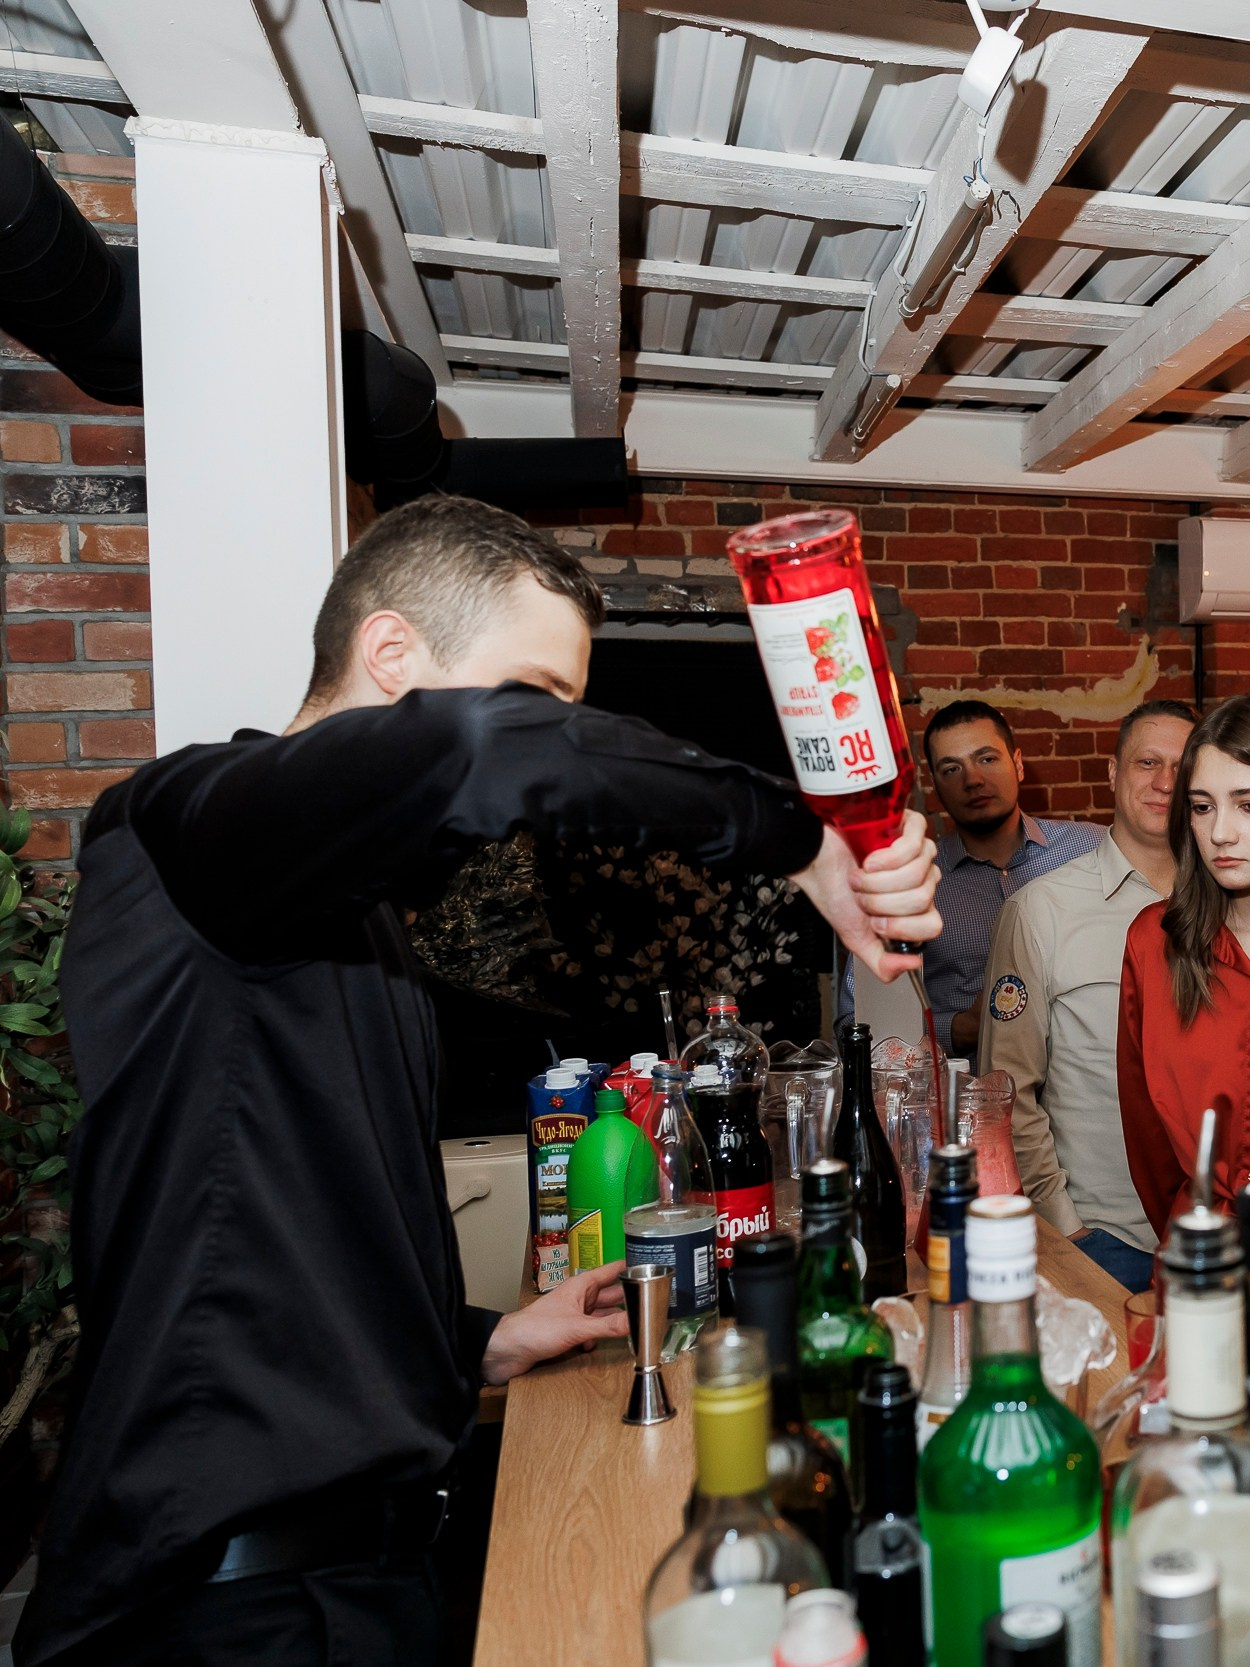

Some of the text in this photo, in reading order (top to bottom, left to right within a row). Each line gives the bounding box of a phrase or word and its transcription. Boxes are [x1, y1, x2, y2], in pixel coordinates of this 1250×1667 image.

[796, 737, 831, 757] CANE
[840, 729, 875, 766] RC
[797, 755, 835, 772] ROYAL
